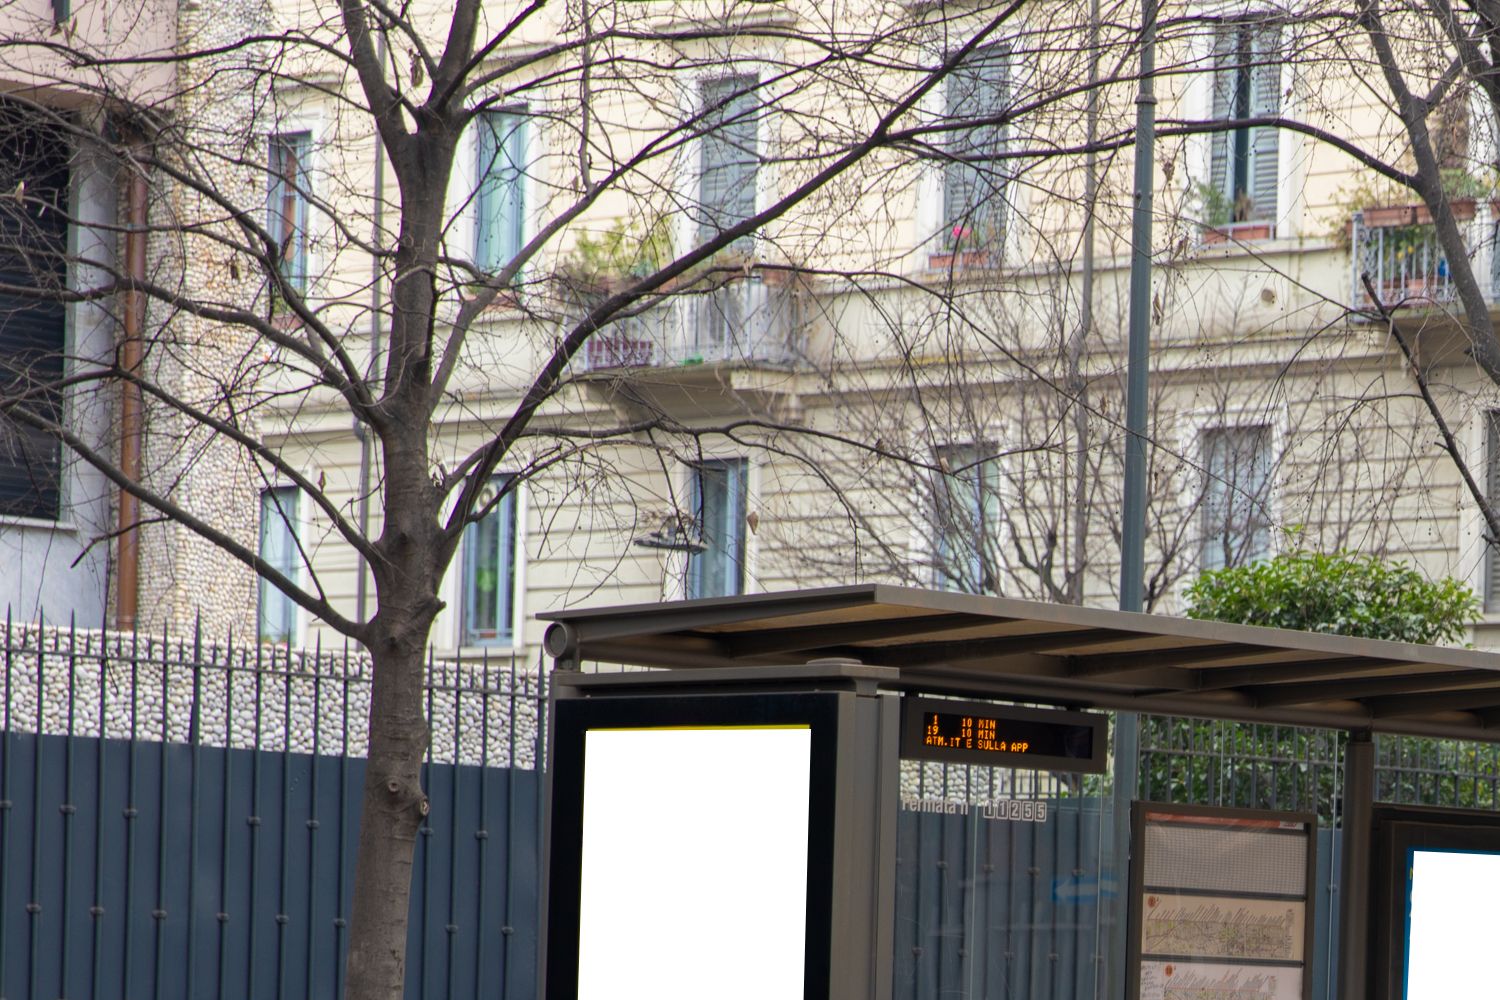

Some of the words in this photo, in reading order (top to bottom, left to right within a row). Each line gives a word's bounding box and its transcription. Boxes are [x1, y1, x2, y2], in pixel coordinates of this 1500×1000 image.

[933, 714, 938, 725] 1
[961, 718, 973, 728] 10
[978, 719, 996, 730] MIN
[927, 725, 939, 735] 19
[961, 728, 973, 738] 10
[977, 729, 996, 740] MIN
[926, 735, 961, 748] ATM.IT
[977, 740, 1007, 752] SULLA
[1011, 742, 1029, 753] APP
[985, 801, 1047, 821] 11255
